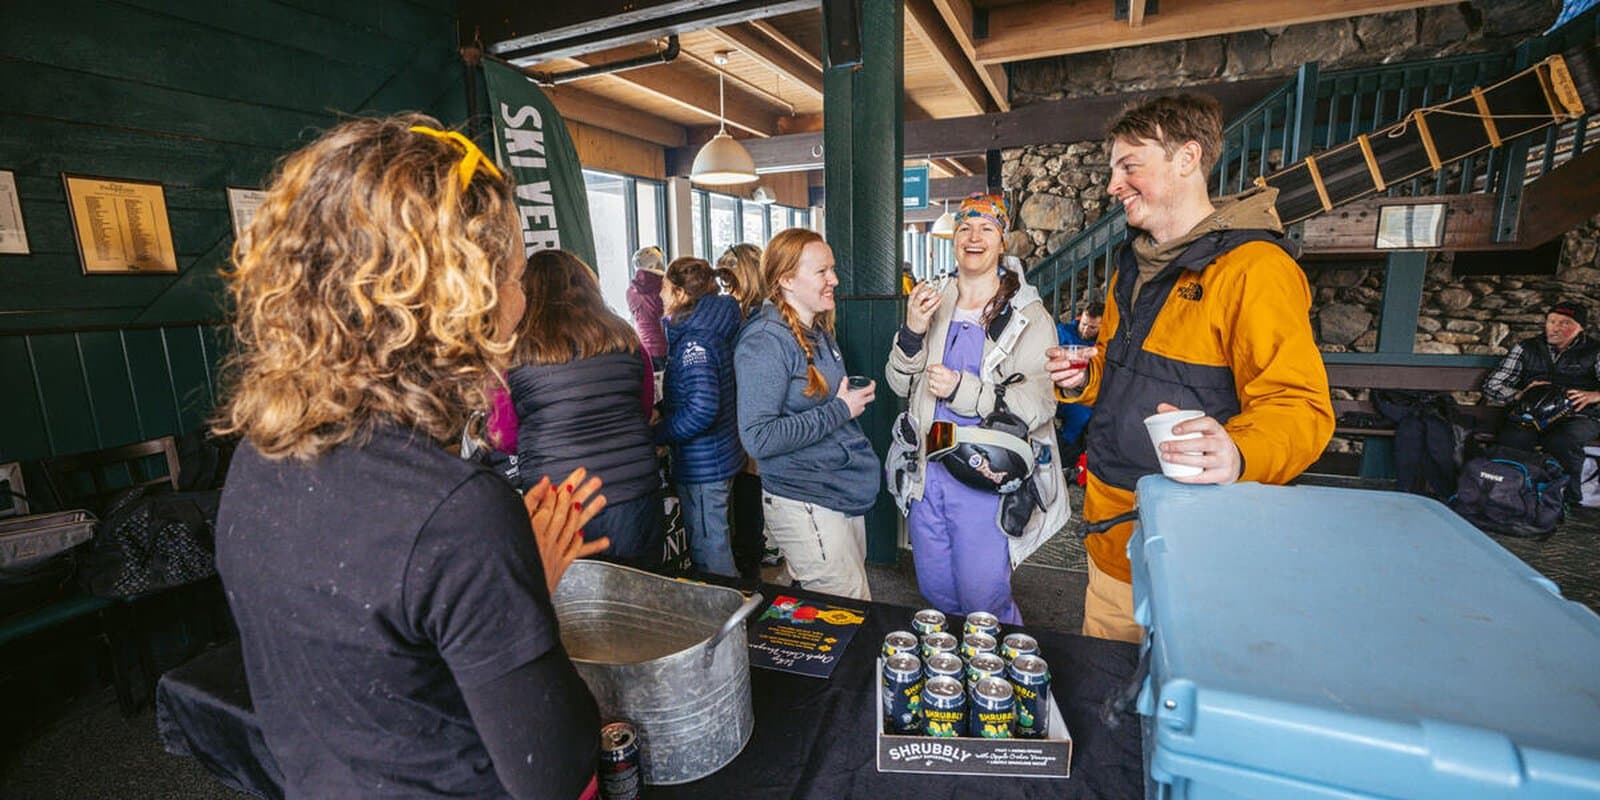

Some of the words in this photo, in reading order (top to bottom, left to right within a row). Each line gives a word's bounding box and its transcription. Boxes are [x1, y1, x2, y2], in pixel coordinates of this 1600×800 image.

[501, 102, 547, 168] SKI
[806, 653, 834, 664] Apple
[889, 743, 972, 762] SHRUBBLY
